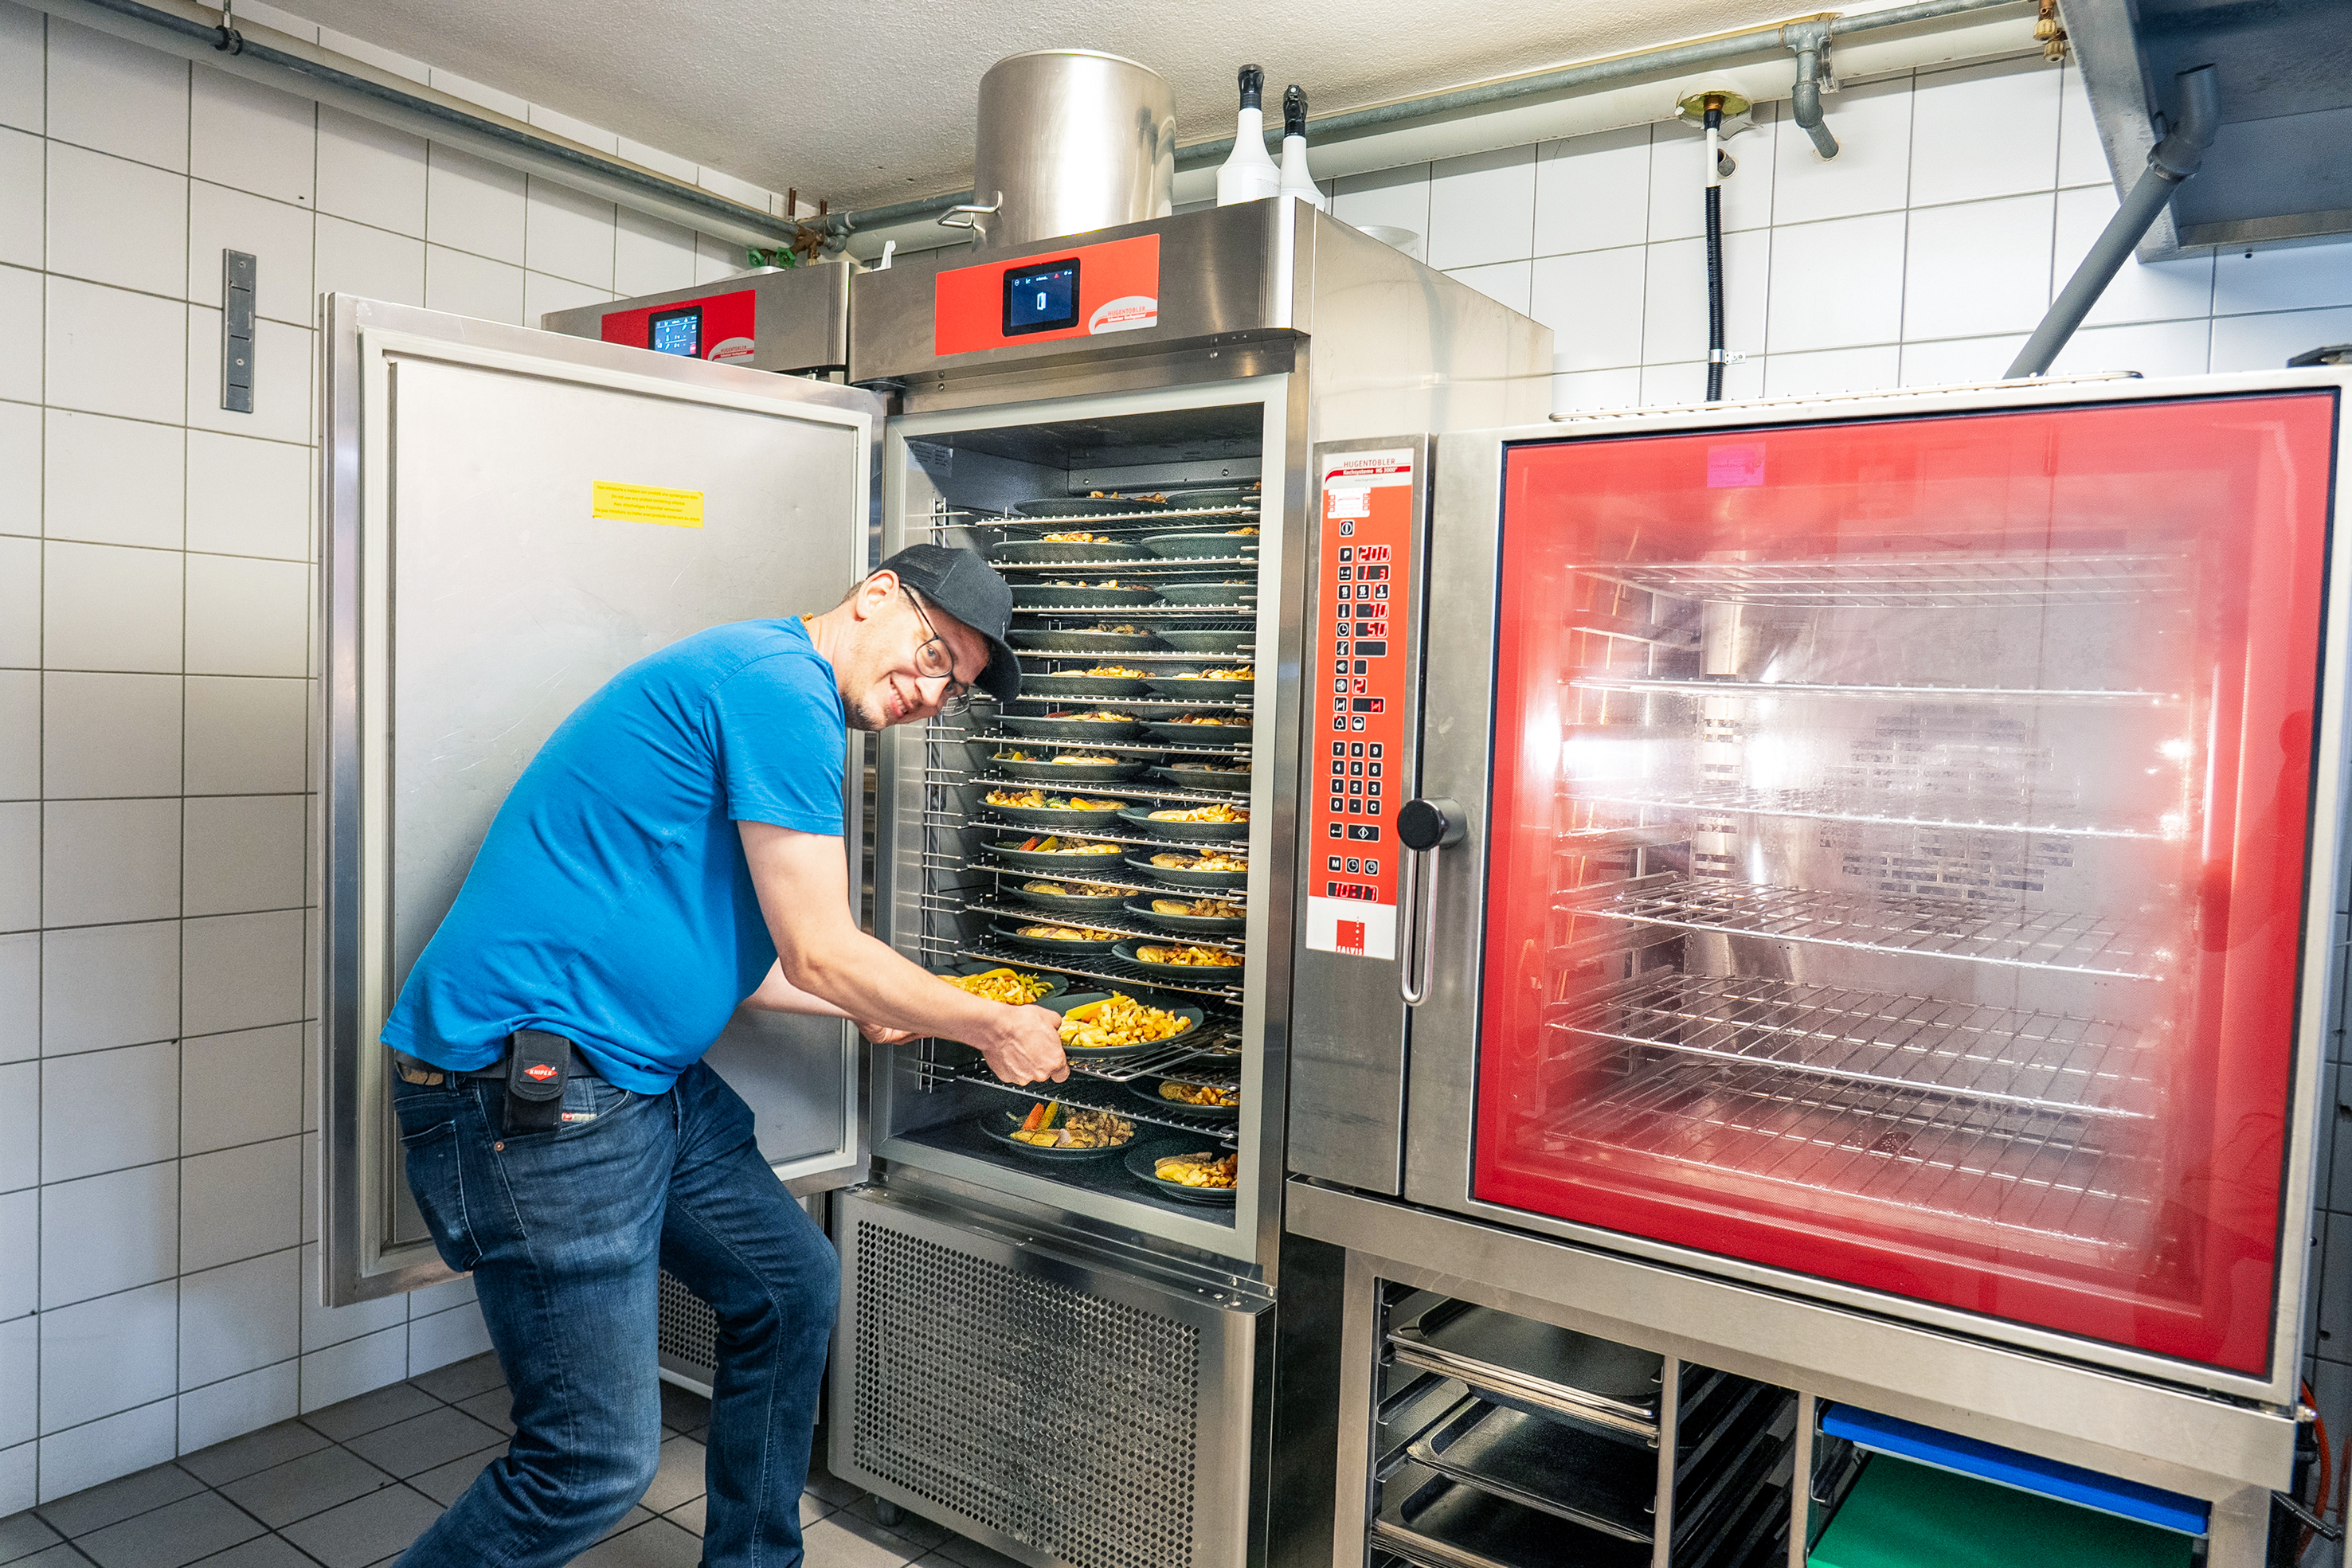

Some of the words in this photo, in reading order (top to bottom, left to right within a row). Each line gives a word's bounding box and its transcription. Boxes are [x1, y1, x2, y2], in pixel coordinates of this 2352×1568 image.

[1107, 306, 1145, 316] HUGENTOBLER
[1344, 459, 1395, 468] HUGENTOBLER
[1344, 549, 1350, 559] P
[1359, 546, 1390, 561] 200
[1370, 604, 1387, 618] 70
[1354, 679, 1365, 693] 2
[1335, 883, 1376, 901] 10:17
[1336, 945, 1363, 956] SALVIS
